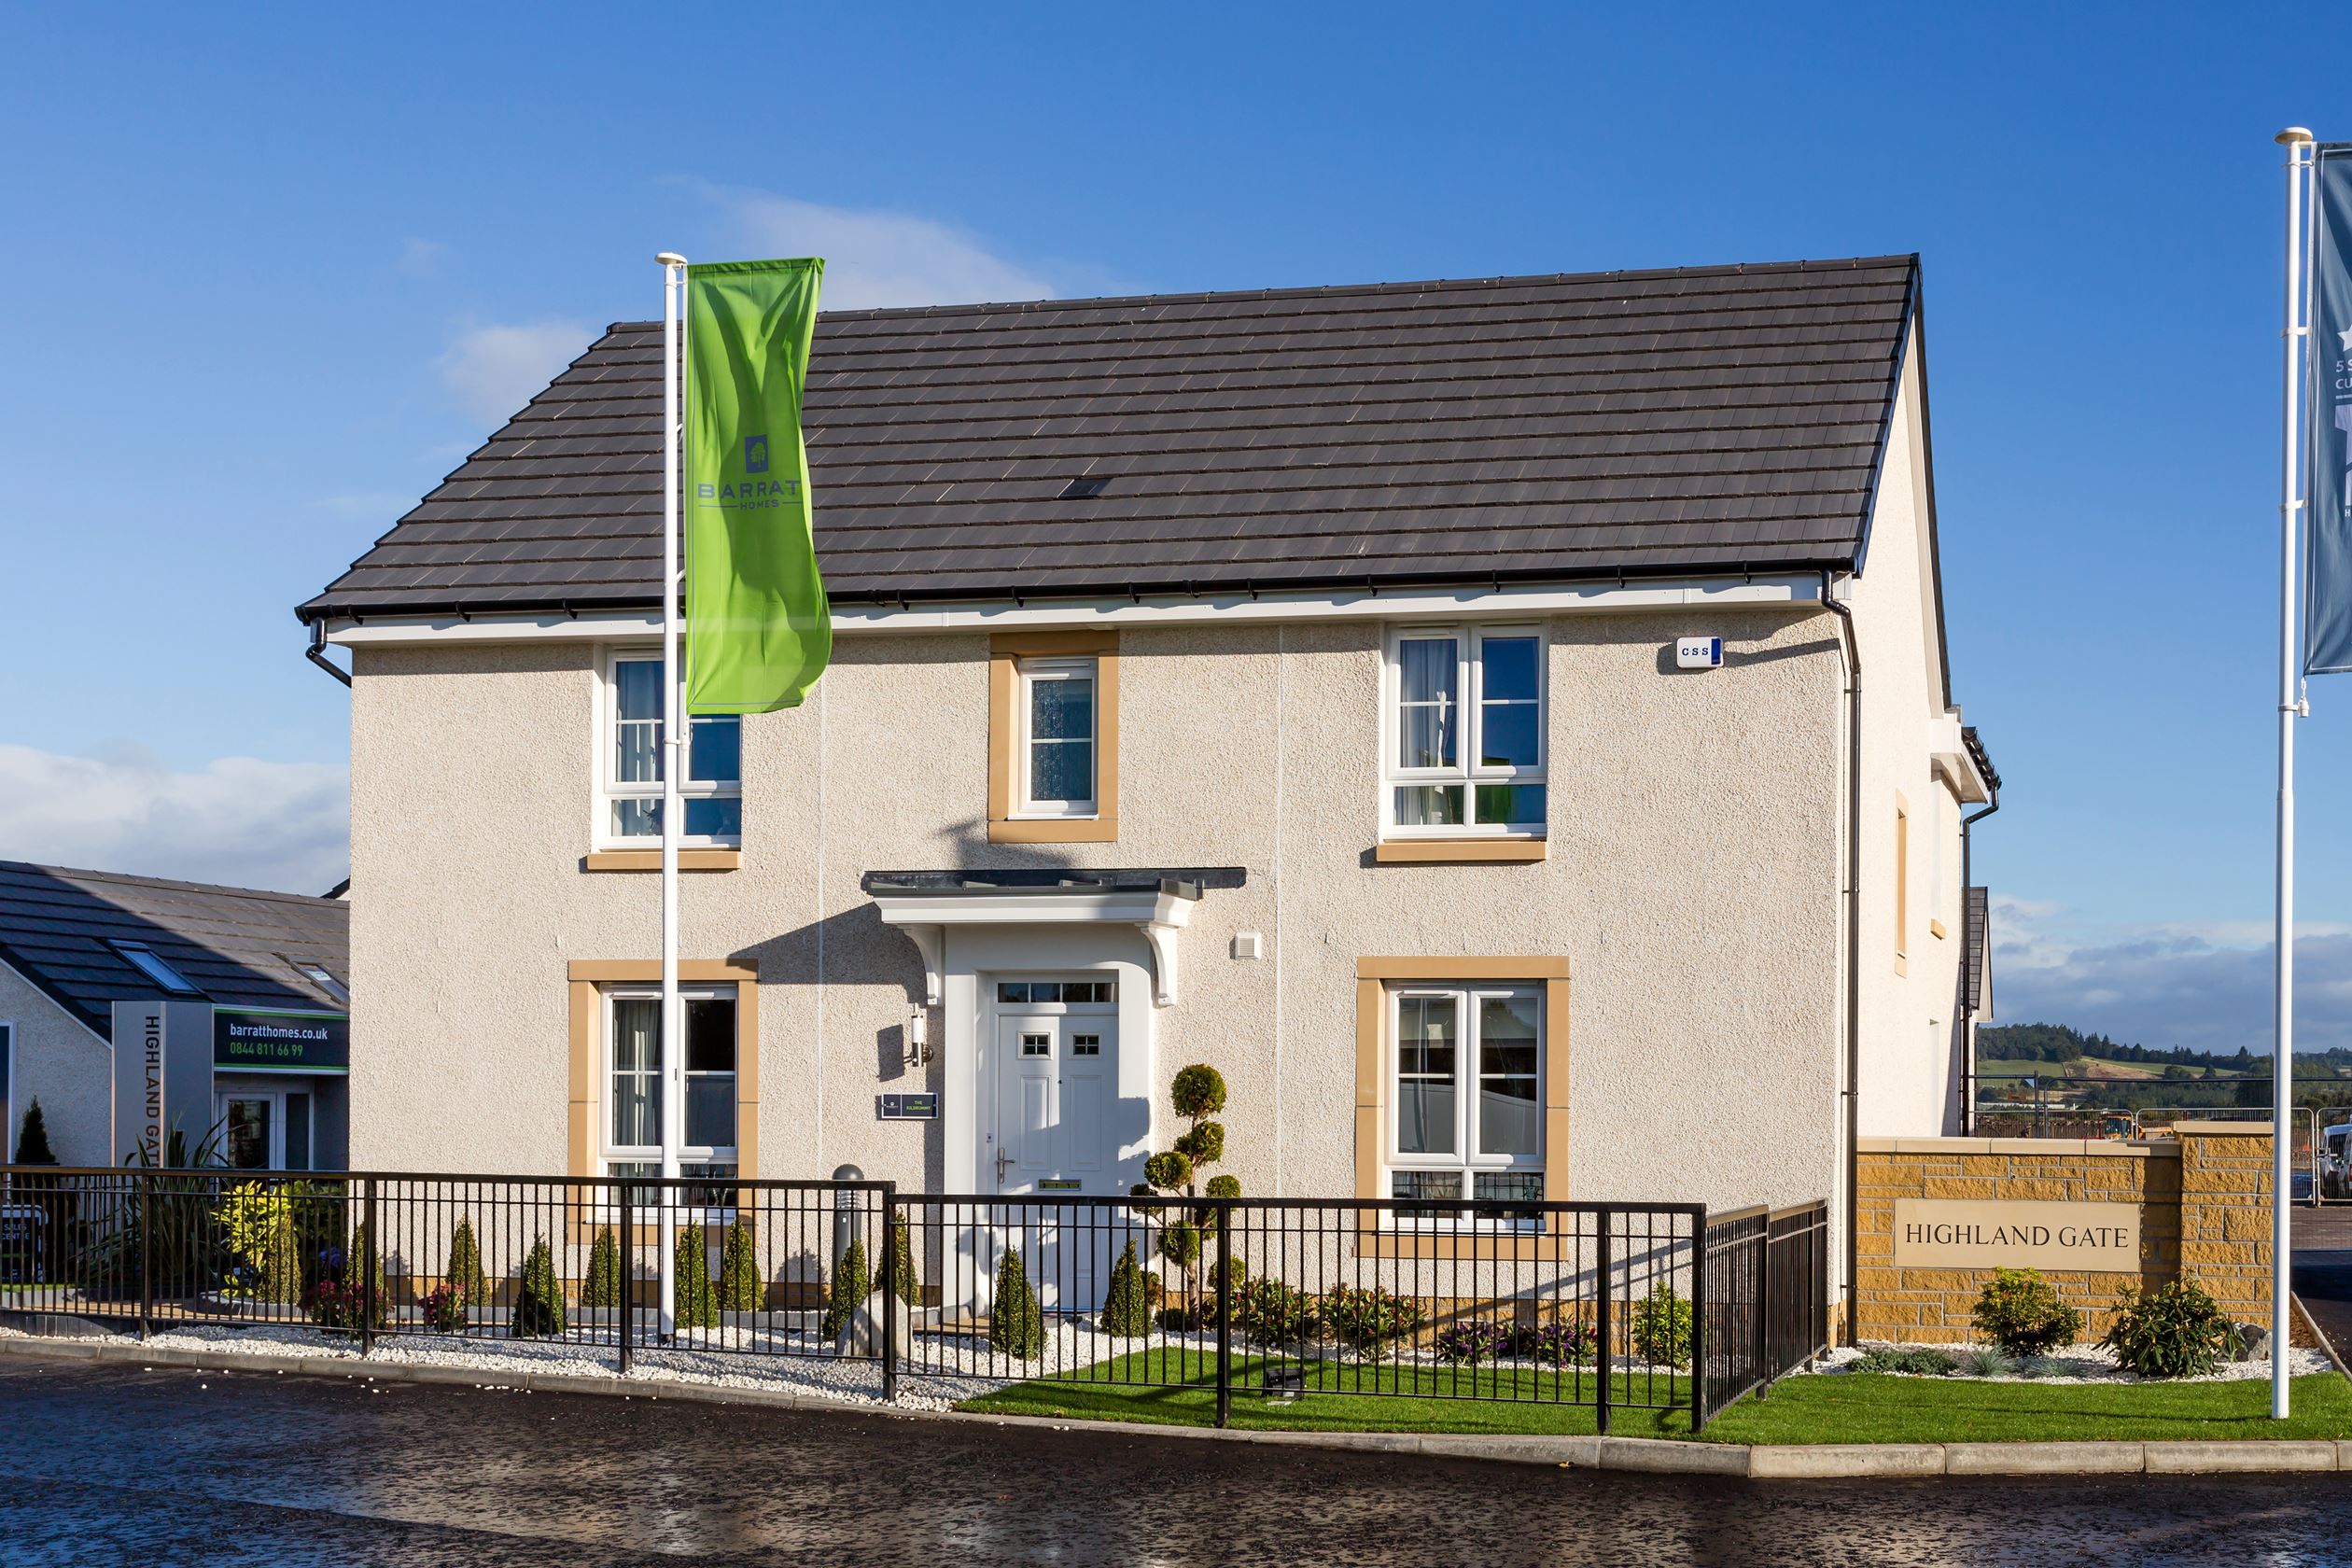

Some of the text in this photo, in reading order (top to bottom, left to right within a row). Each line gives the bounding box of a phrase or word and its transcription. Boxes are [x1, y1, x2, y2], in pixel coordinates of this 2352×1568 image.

[2335, 360, 2345, 372] 5
[740, 499, 779, 511] HOMES
[230, 1023, 329, 1040] barratthomes.co.uk
[230, 1042, 303, 1057] 0844 811 66 99
[146, 1015, 160, 1119] HIGHLAND
[1906, 1224, 2129, 1248] HIGHLAND GATE
